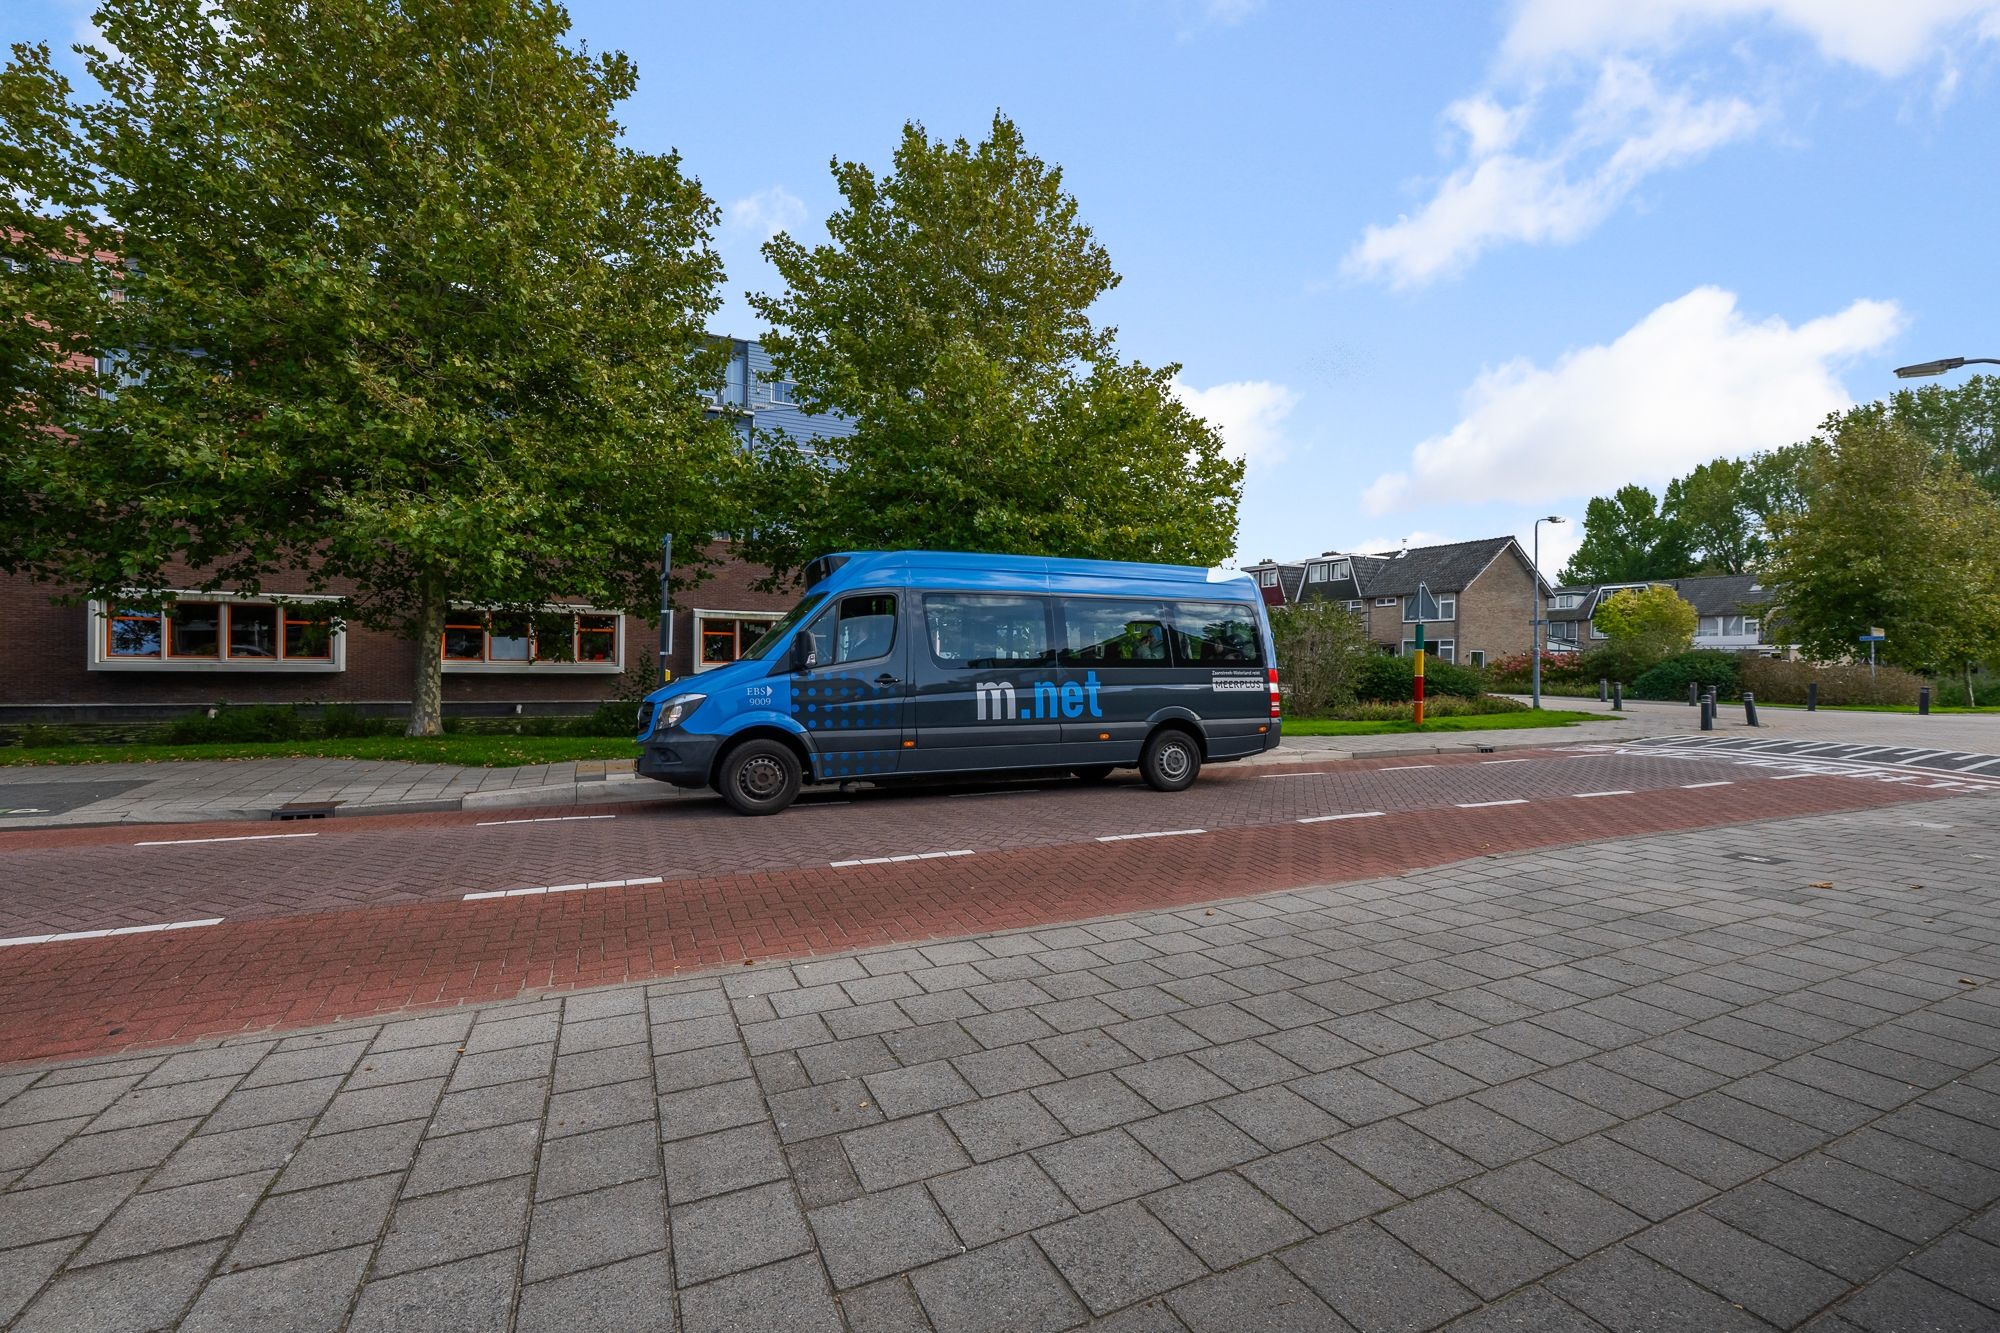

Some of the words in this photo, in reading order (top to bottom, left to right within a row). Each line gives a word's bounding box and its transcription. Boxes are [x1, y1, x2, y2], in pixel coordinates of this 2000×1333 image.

[1215, 680, 1261, 689] MEERPLUS
[746, 687, 766, 696] EBS
[976, 670, 1103, 720] m.net
[749, 697, 772, 706] 9009
